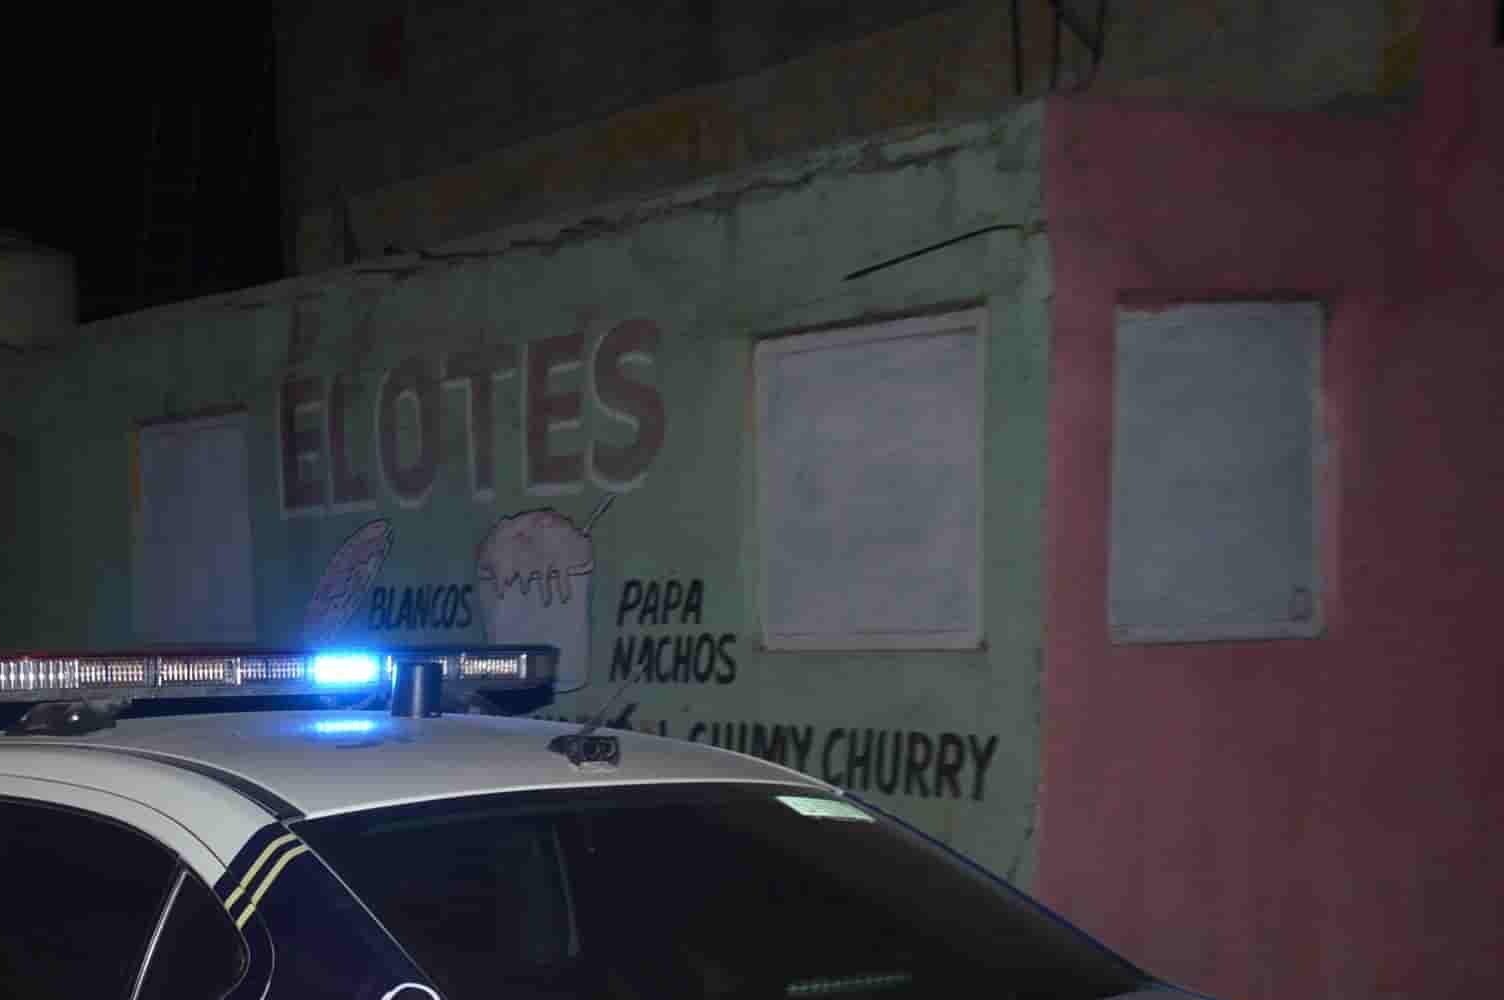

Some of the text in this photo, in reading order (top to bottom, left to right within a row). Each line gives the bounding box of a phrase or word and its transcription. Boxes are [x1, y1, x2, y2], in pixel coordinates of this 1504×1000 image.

[280, 317, 668, 513] ELOTES
[368, 583, 473, 631] BLANCOS
[616, 580, 703, 627] PAPA
[610, 634, 737, 686] NACHOS
